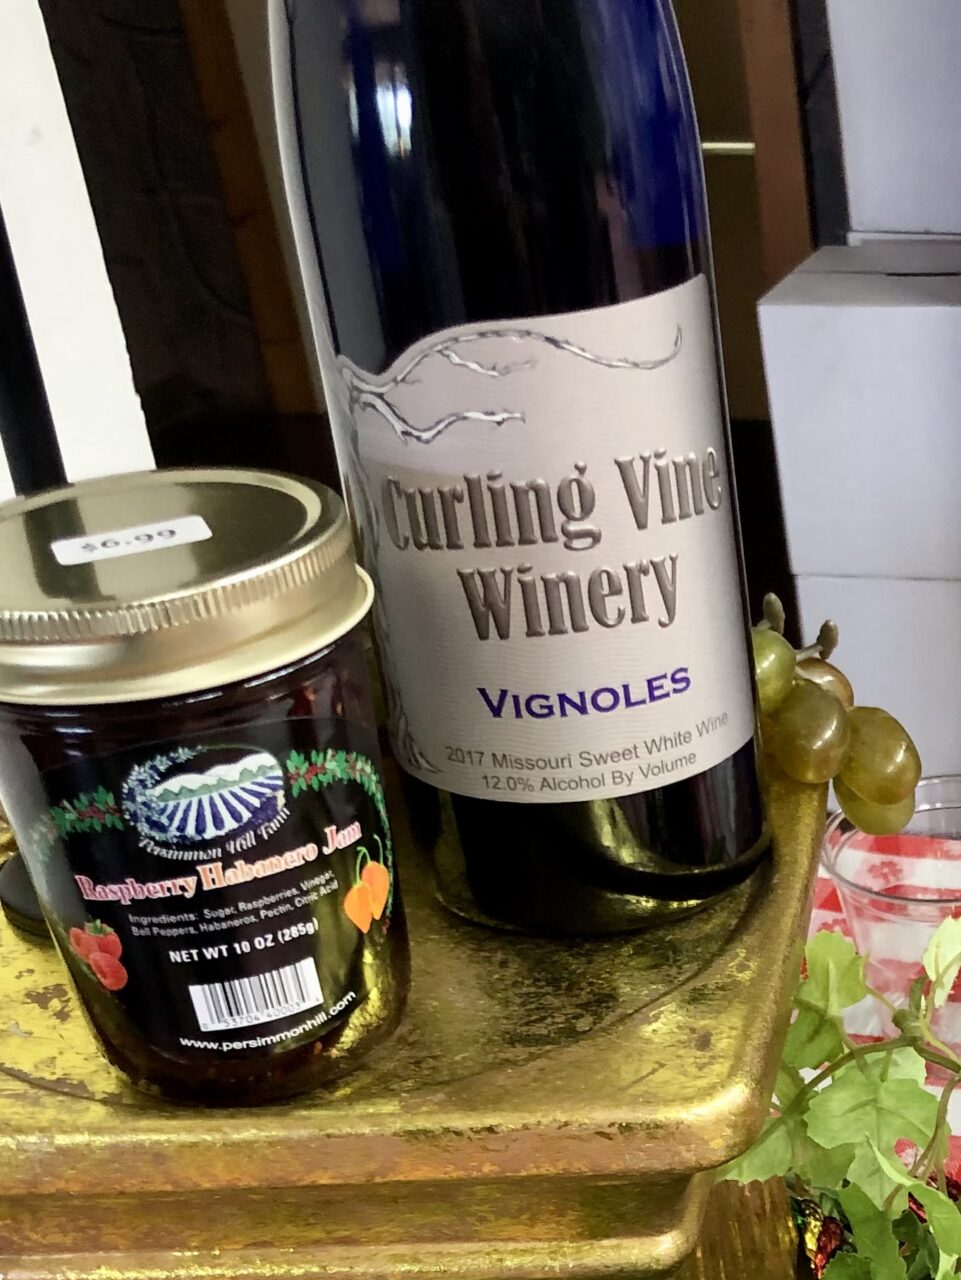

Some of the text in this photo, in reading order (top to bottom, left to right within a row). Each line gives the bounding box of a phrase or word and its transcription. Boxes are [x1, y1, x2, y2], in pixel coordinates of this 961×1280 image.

[381, 446, 722, 552] Curling Vine
[81, 529, 176, 553] $6.99
[457, 552, 679, 641] Winery
[477, 666, 692, 719] VIGNOLES
[445, 710, 729, 771] 2017 Missouri Sweet White Wine
[482, 751, 697, 793] 12.0% Alcohol By Volume
[74, 821, 363, 906] Raspberry Habanero Jam
[128, 913, 199, 926] Ingredients:
[168, 917, 320, 964] NET WT 10 OZ (285g)
[179, 991, 357, 1052] www.persimmonhill.com
